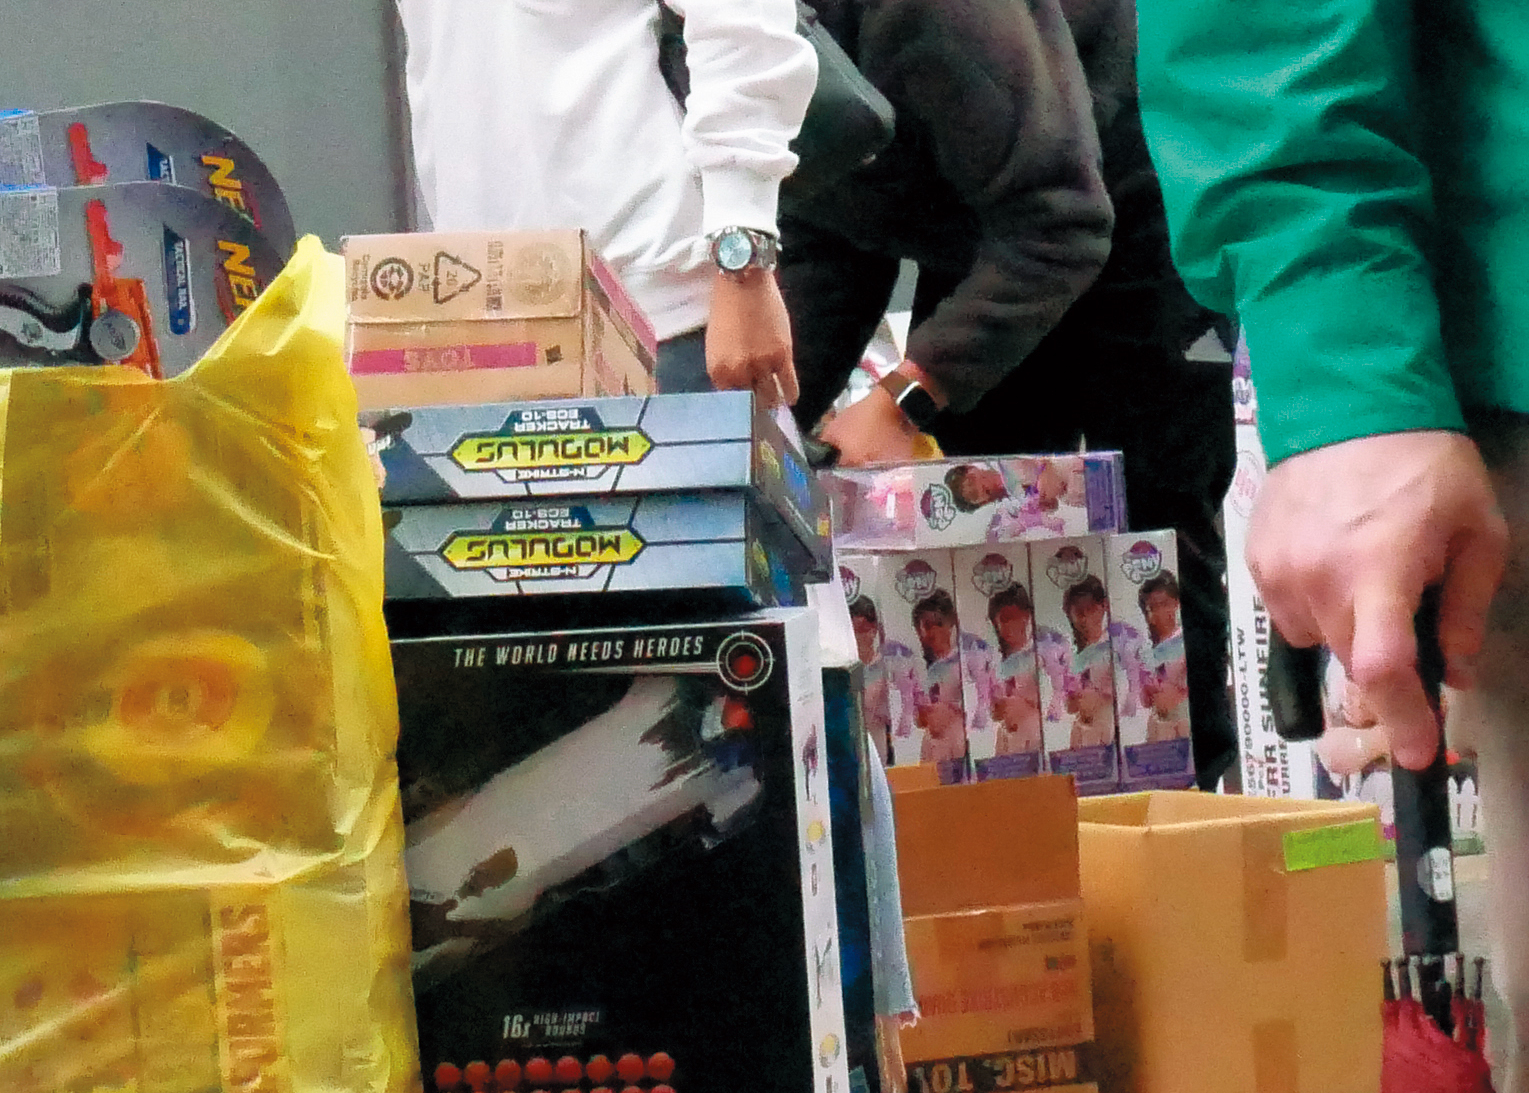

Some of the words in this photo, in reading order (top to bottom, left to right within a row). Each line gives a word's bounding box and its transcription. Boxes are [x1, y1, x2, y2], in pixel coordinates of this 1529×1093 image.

[515, 420, 590, 433] TRACKER
[476, 433, 629, 464] MODULUS
[505, 519, 581, 531] TRACKER
[466, 534, 621, 563] MODULUS
[454, 648, 486, 668] THE
[495, 644, 557, 666] WORLD
[568, 641, 624, 663] NEEDS
[633, 636, 704, 658] HEROES
